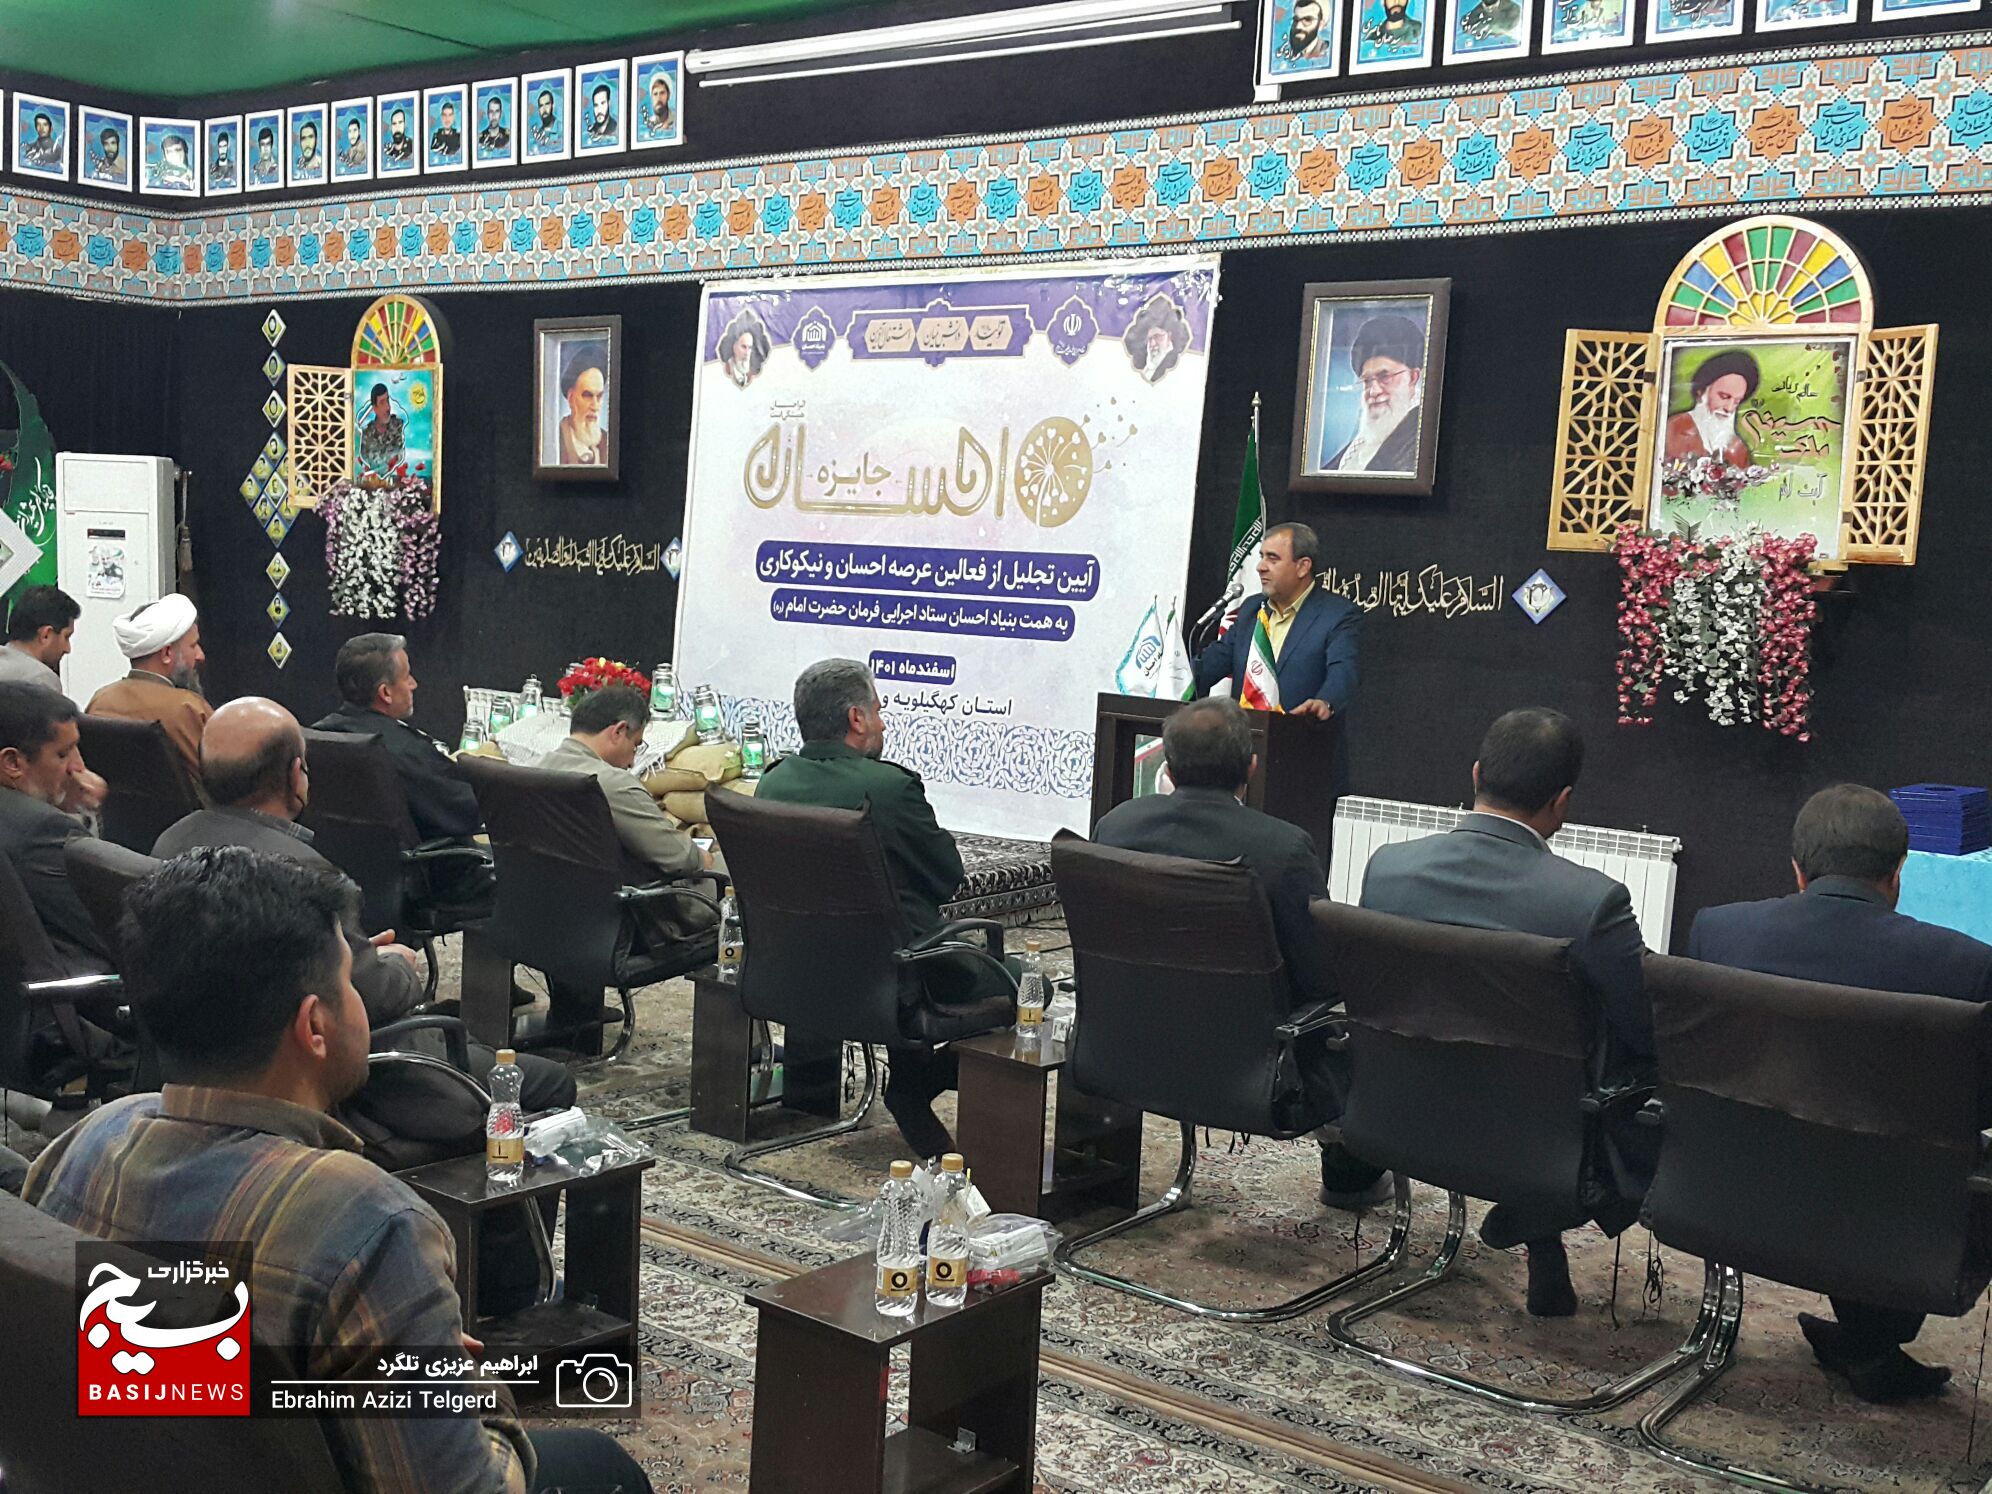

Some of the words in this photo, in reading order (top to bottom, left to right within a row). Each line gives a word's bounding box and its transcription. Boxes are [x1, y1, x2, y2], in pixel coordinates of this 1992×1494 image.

[817, 452, 892, 496] جایزه
[759, 549, 824, 576] نیکوکاری
[825, 562, 833, 580] و
[835, 553, 885, 579] احسان
[888, 561, 932, 585] عرصه
[935, 557, 987, 587] فعالین
[990, 560, 1002, 591] از
[1004, 561, 1056, 591] تجلیل
[1057, 559, 1095, 593] آیین
[785, 596, 806, 619] امام
[809, 600, 847, 620] حضرت
[849, 600, 880, 620] فرمان
[881, 604, 917, 625] اجرایی
[919, 606, 947, 623] ستاد
[949, 607, 989, 628] احسان
[991, 610, 1017, 631] بنیاد
[1019, 612, 1053, 629] همت
[1055, 616, 1069, 635] به
[893, 690, 958, 715] کهگیلویه
[962, 696, 1012, 716] استان
